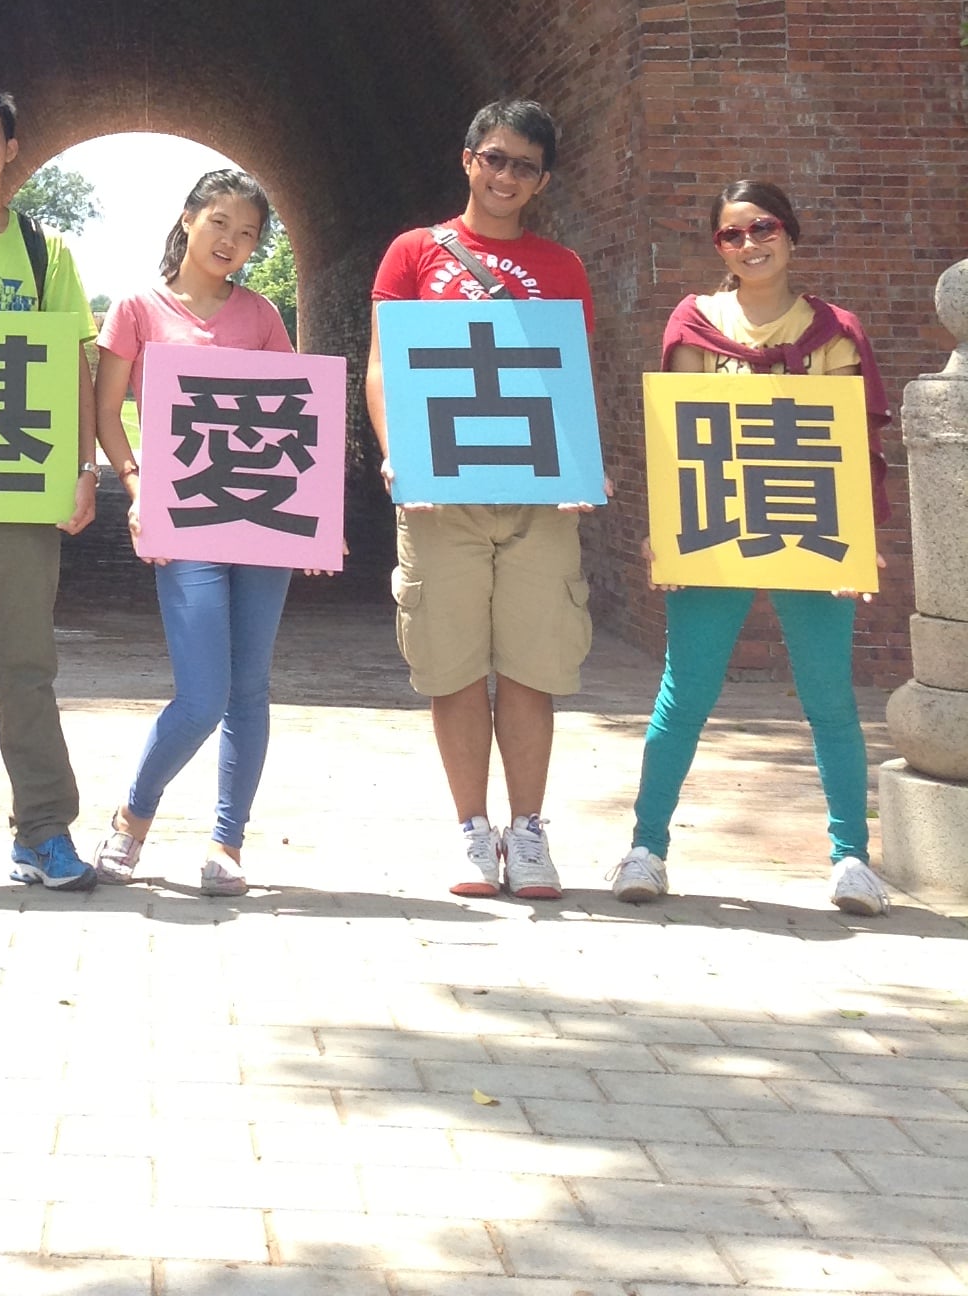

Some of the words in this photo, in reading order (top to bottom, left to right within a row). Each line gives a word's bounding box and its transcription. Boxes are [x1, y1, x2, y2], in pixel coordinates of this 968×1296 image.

[430, 254, 544, 300] ABEROMBI
[168, 374, 319, 538] 愛
[408, 321, 562, 478] 古
[674, 398, 850, 563] 蹟
